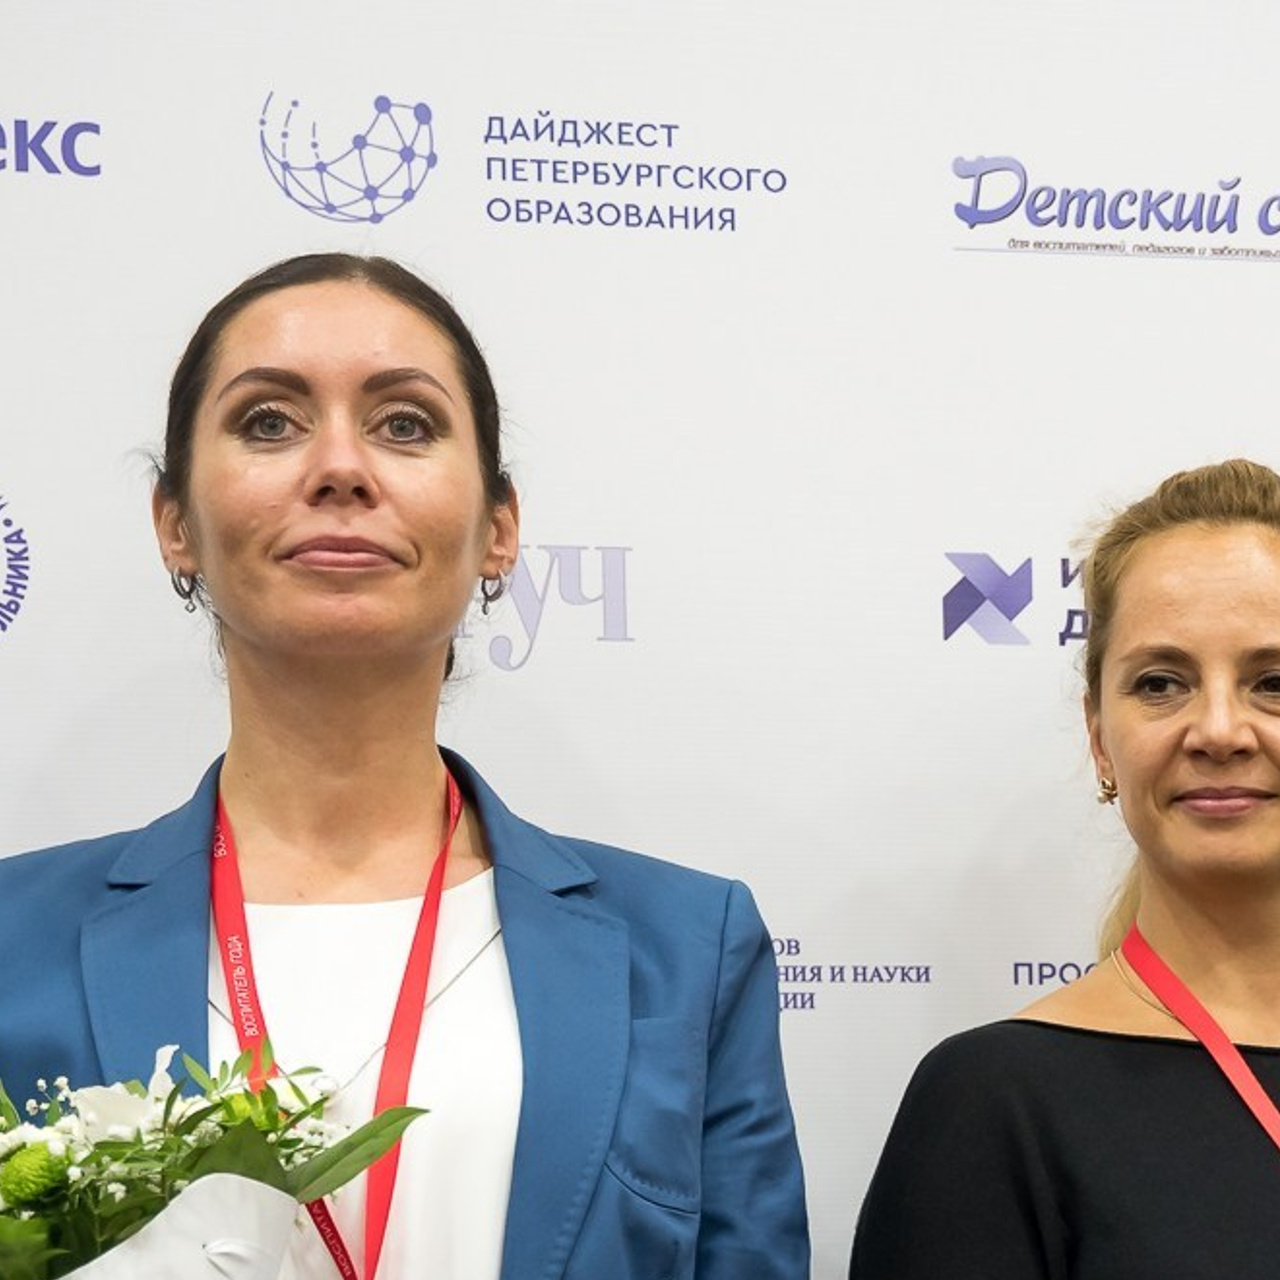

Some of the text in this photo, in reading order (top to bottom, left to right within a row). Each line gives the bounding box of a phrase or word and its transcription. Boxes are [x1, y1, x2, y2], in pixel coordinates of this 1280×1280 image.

[0, 119, 101, 176] кс
[484, 110, 680, 148] ДАЙДЖЕСТ
[485, 156, 788, 193] ПЕТЕРБУРГСКОГО
[952, 155, 1242, 235] Детский
[486, 197, 737, 232] ОБРАЗОВАНИЯ
[1007, 238, 1030, 250] для
[226, 934, 260, 1037] ВОСПИТАТЕЛЬ ГОДА
[830, 965, 846, 983] И
[852, 965, 932, 984] НАУКИ
